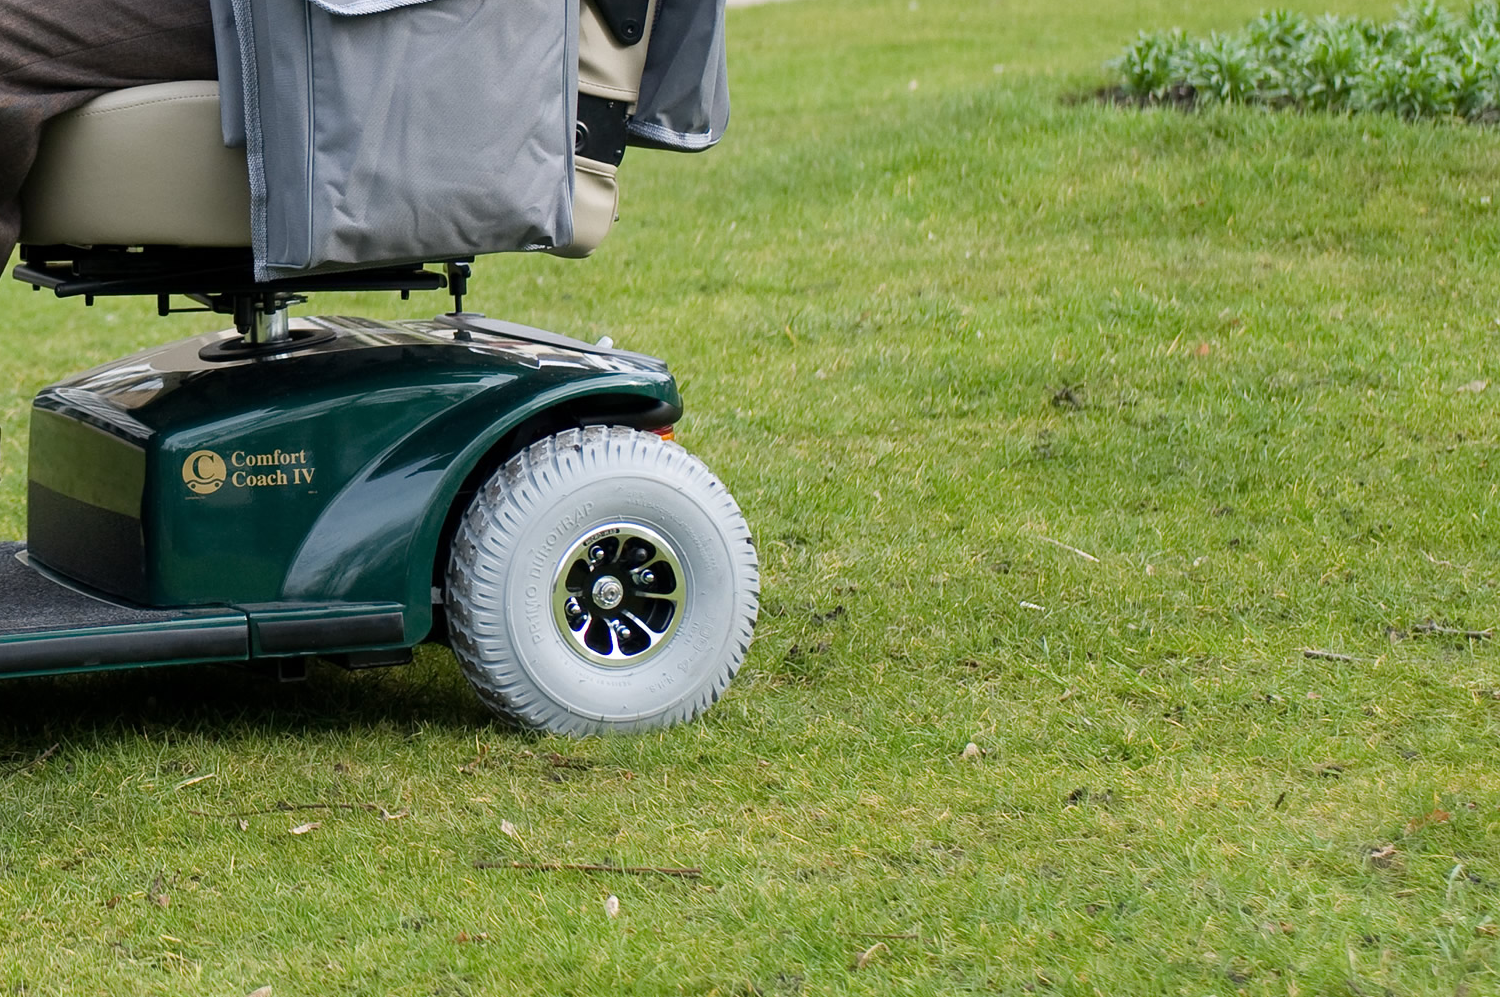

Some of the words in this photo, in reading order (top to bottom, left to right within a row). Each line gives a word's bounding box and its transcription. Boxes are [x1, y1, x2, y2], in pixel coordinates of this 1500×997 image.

[231, 449, 307, 467] Comfort
[231, 469, 288, 488] Coach
[293, 467, 316, 484] IV
[529, 500, 595, 579] DUROTRAP
